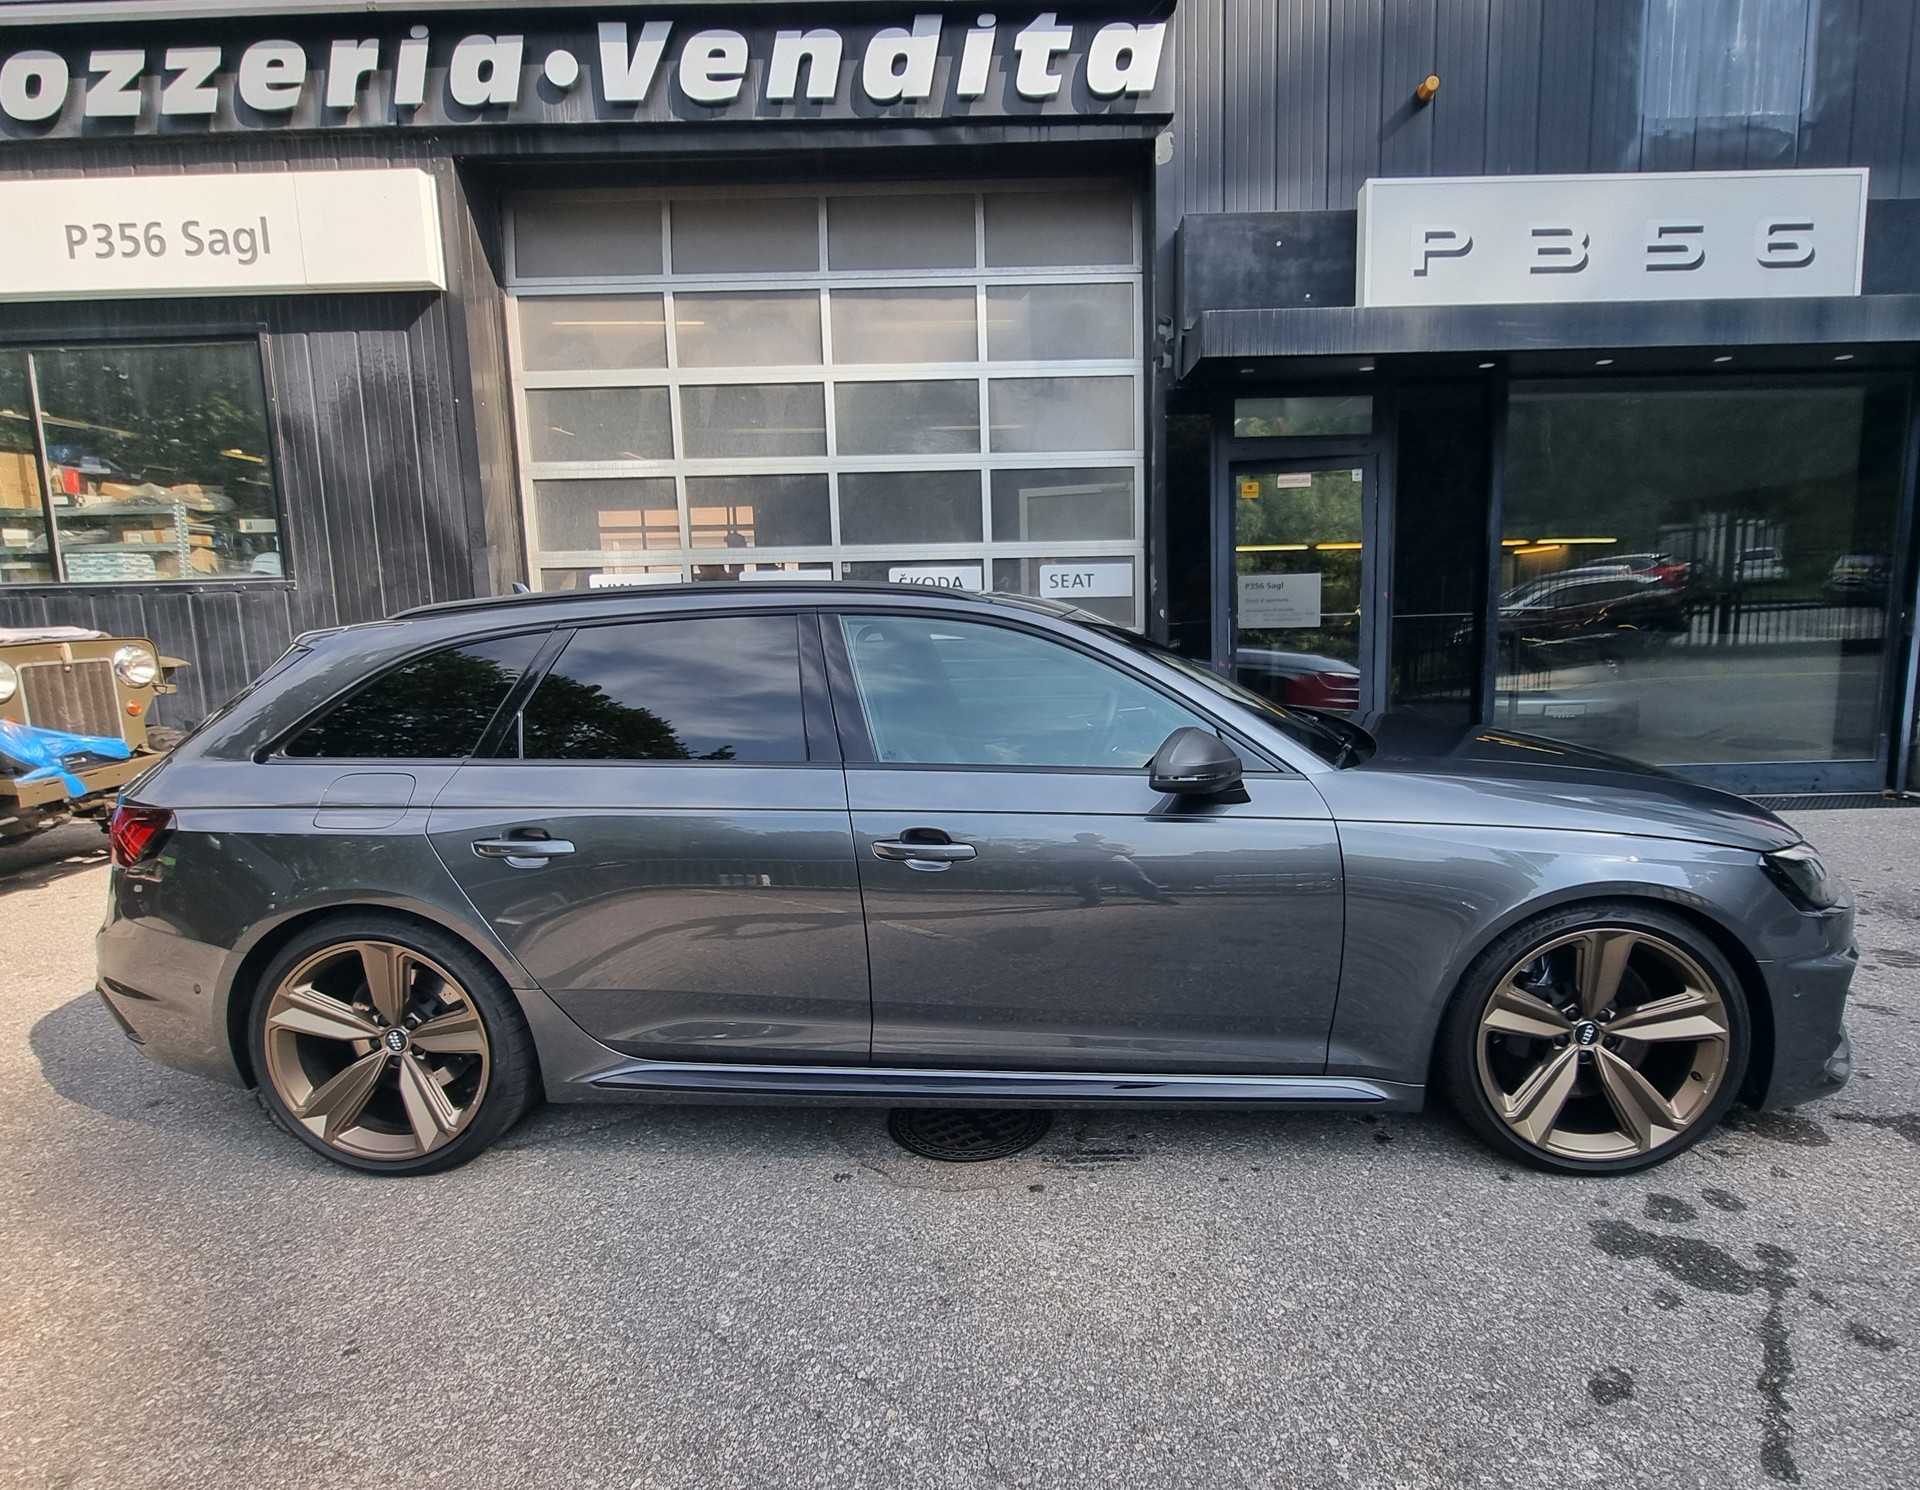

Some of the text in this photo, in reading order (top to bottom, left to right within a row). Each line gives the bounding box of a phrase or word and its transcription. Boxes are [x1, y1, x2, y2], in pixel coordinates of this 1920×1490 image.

[64, 216, 271, 266] P356 Sagl
[1049, 573, 1095, 589] SEAT
[1245, 581, 1284, 592] P356 Sagl
